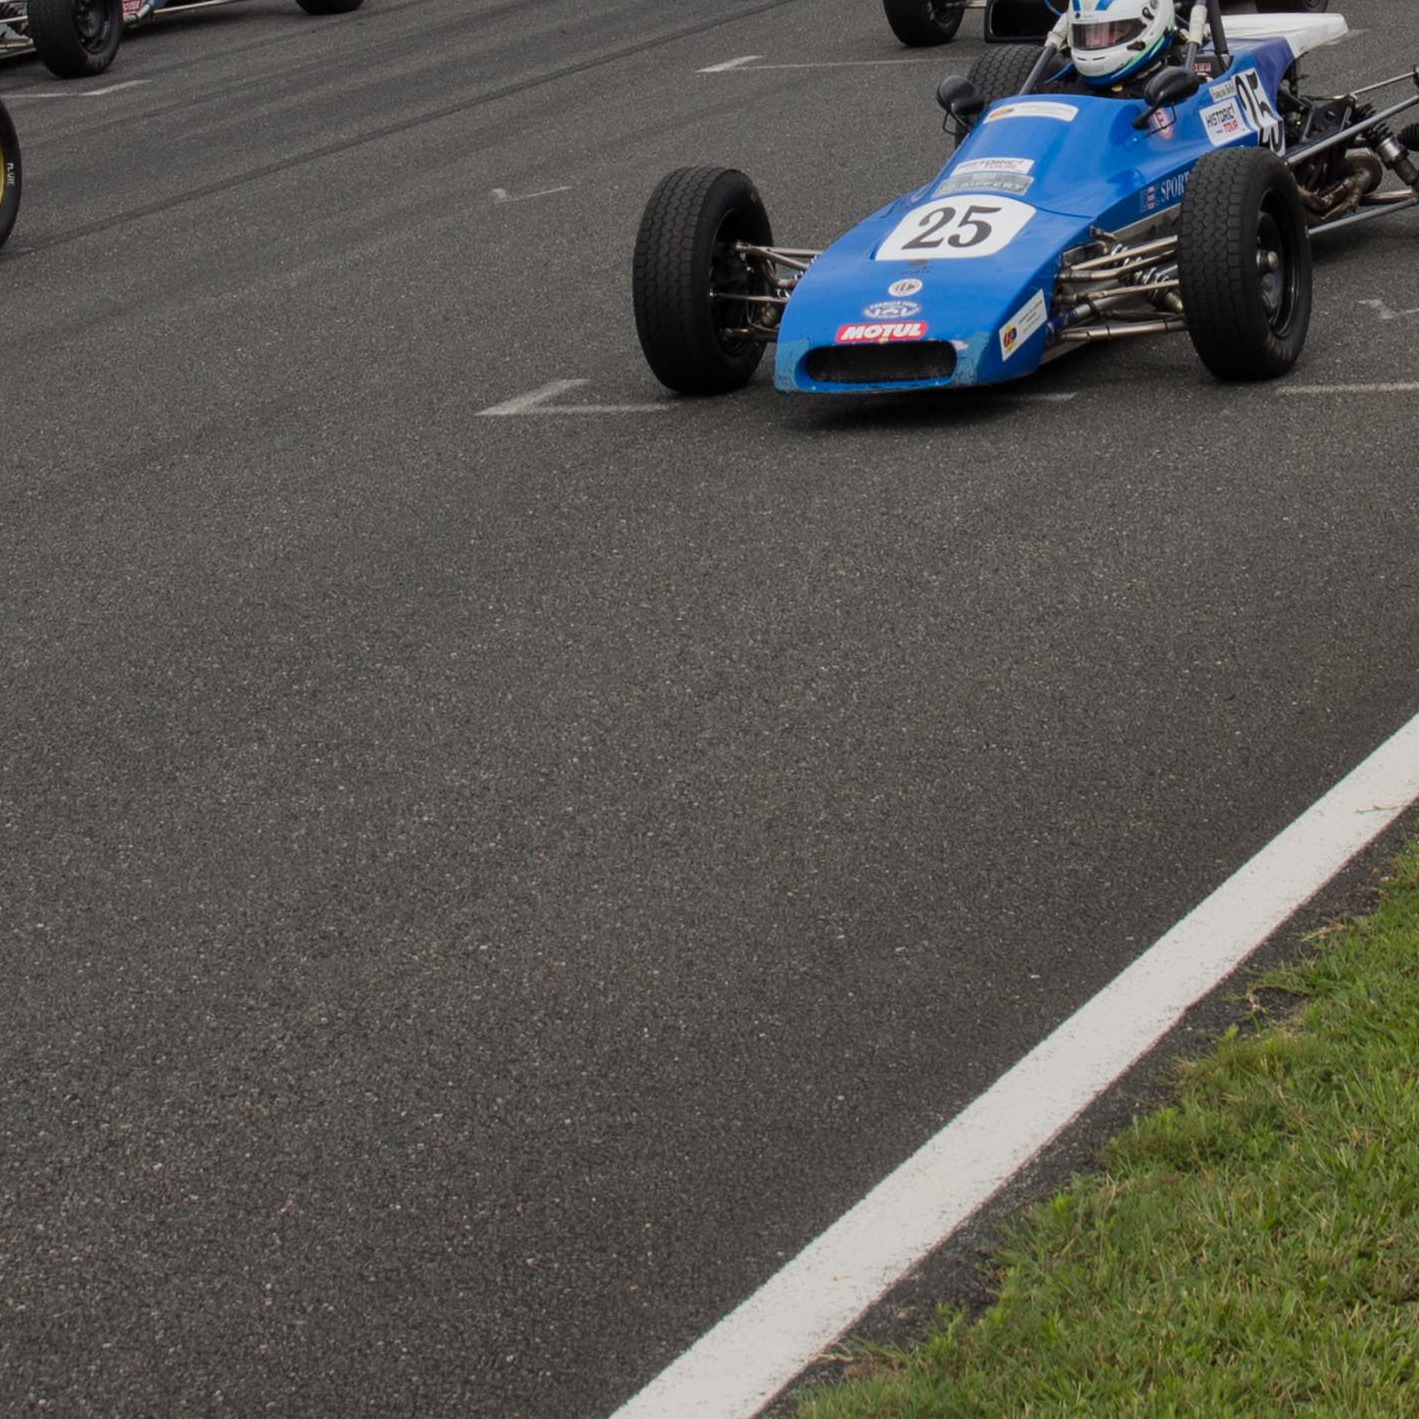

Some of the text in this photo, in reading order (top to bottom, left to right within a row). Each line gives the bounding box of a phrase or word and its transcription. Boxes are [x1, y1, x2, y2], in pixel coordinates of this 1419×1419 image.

[1234, 70, 1282, 153] 25
[901, 205, 1002, 250] 25
[841, 322, 922, 341] MOTUL
